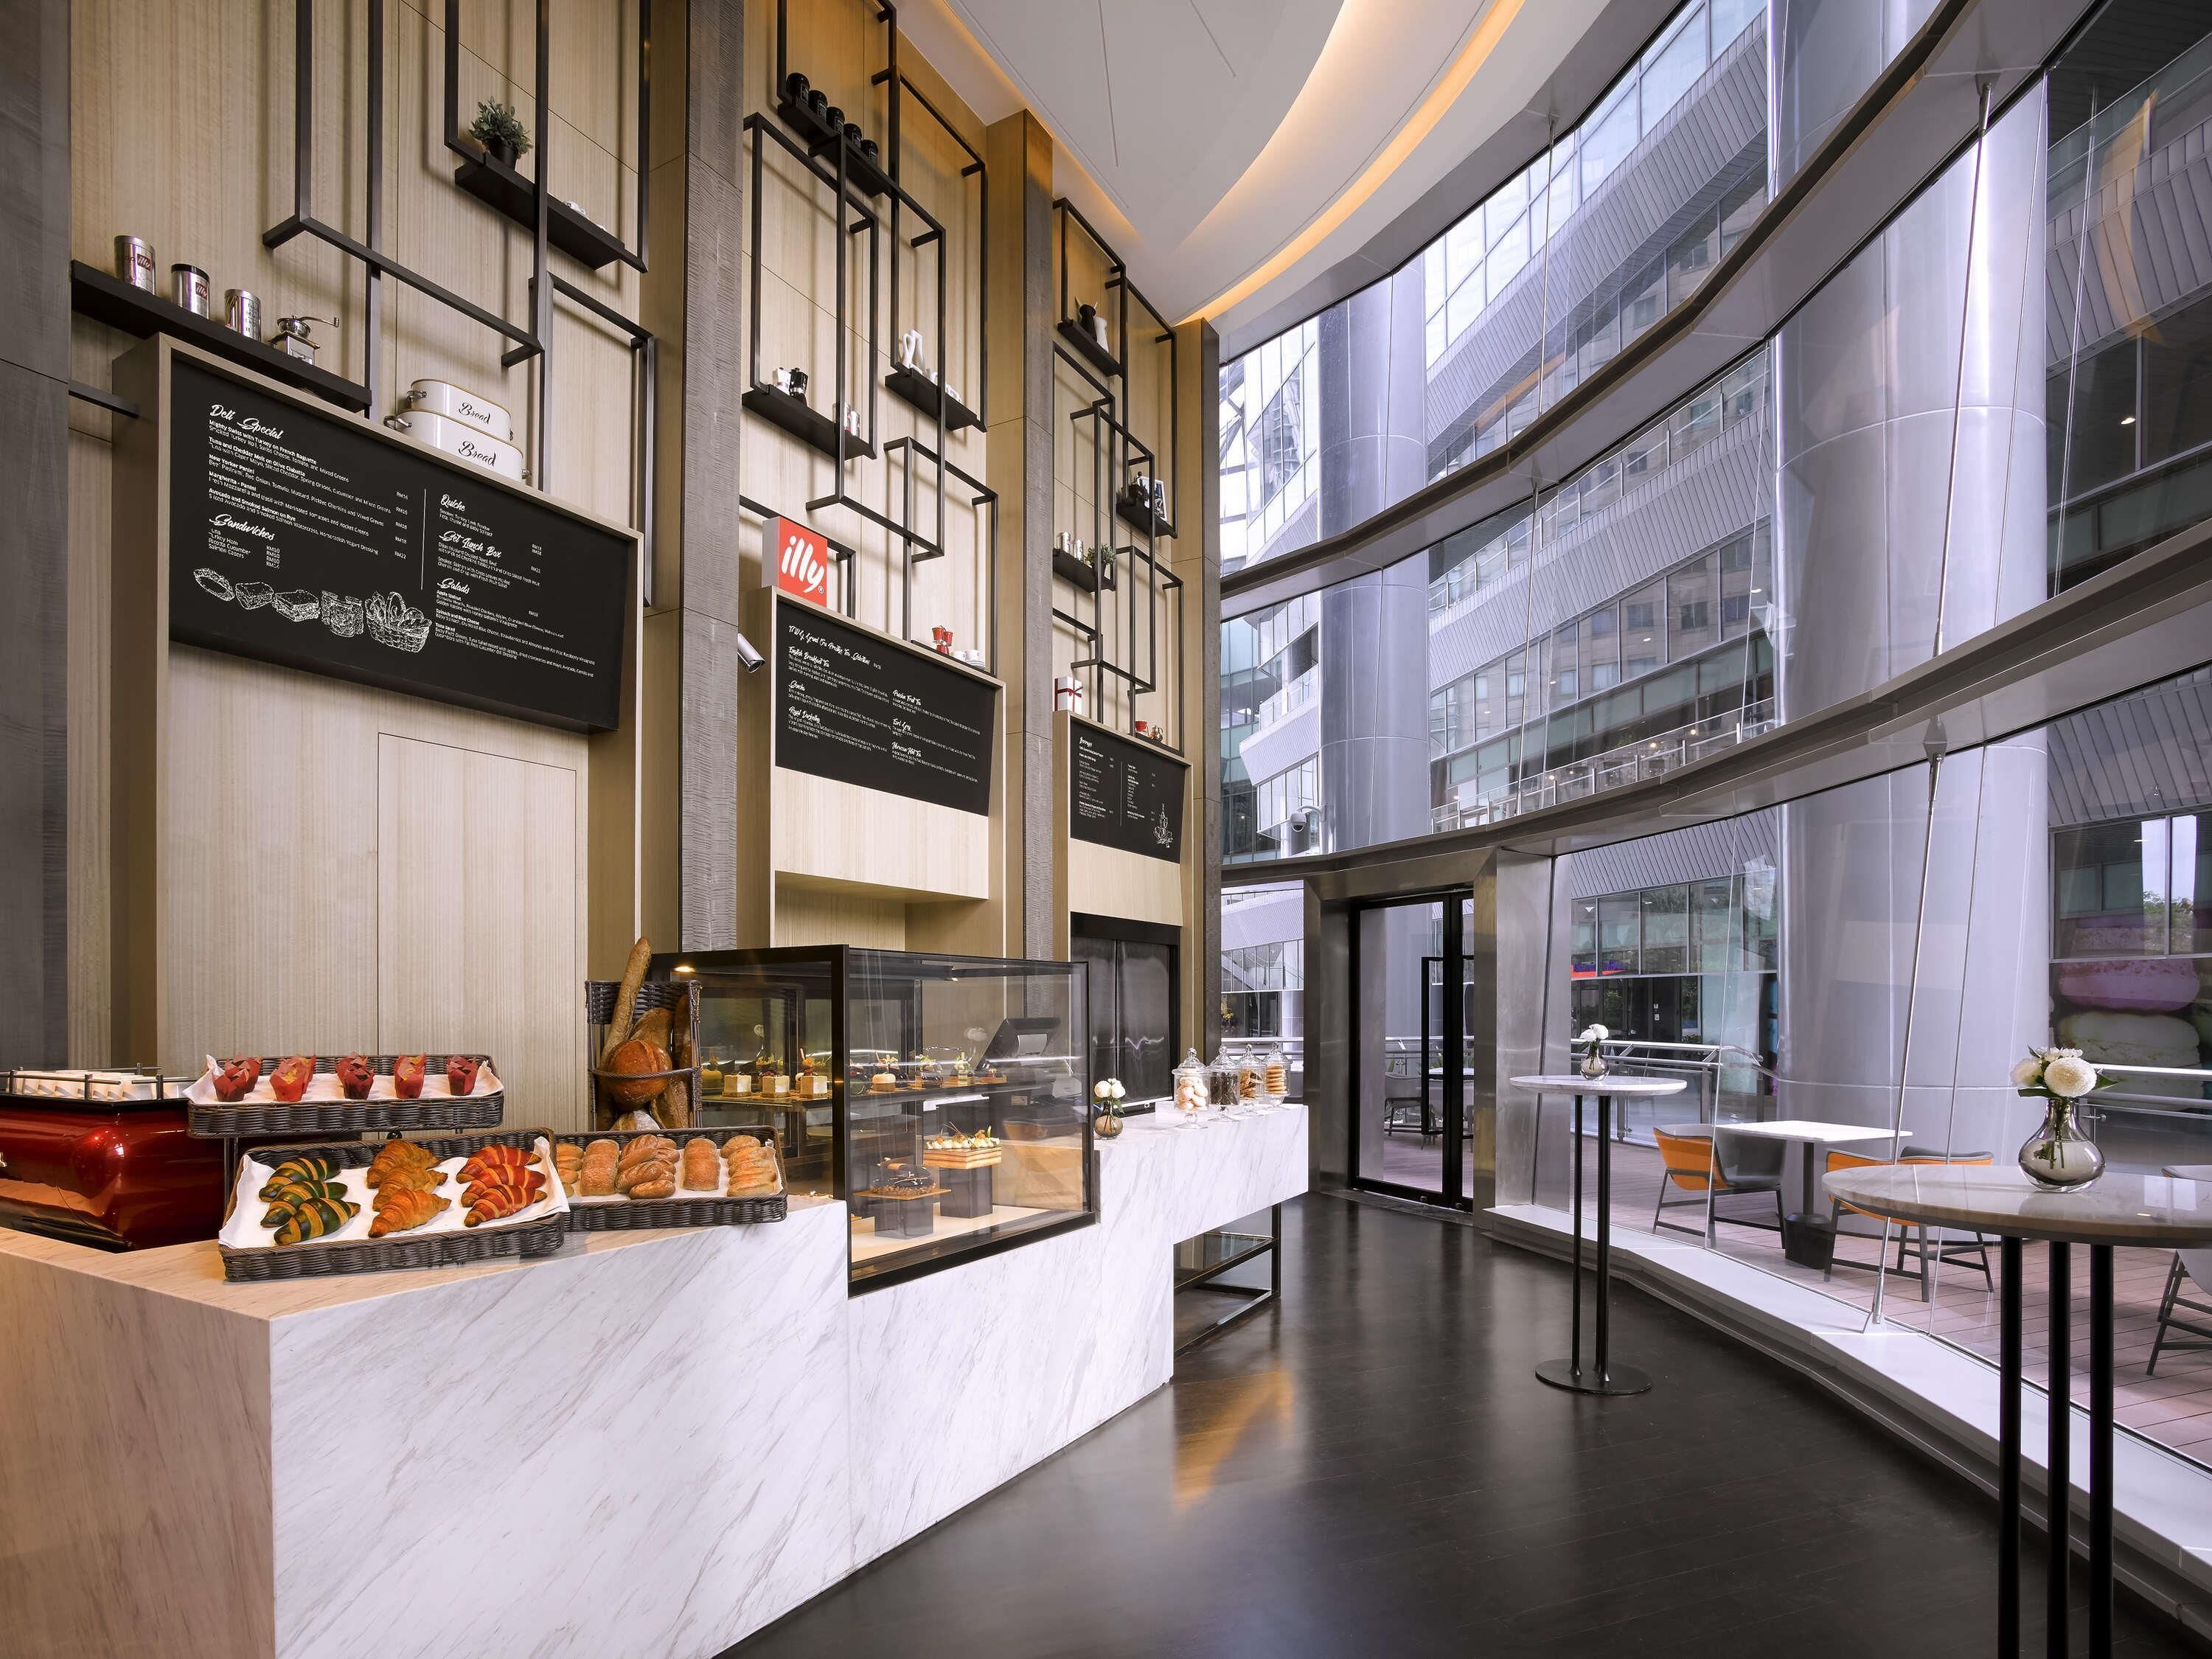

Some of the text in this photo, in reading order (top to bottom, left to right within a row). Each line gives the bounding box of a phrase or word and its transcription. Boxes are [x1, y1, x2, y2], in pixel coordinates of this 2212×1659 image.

[209, 404, 284, 439] Deli Special
[458, 402, 491, 424] Bread
[209, 420, 226, 431] Mighty
[228, 427, 242, 436] Swiss
[243, 433, 254, 441] with
[254, 437, 271, 448] Turkey
[279, 446, 295, 456] French
[296, 453, 316, 465] Baguette
[458, 441, 496, 467] Bread
[209, 437, 222, 445] Tuna
[233, 445, 253, 457] Cheddar
[254, 453, 265, 462] Melt
[273, 461, 285, 469] Olive
[286, 465, 305, 476] Ciabatta
[221, 458, 237, 468] Yorker
[239, 465, 254, 474] Panini
[209, 470, 256, 491] Margherita Panini
[209, 488, 230, 499] Avocado
[241, 498, 260, 509] Smoked
[261, 506, 279, 515] Salmon
[440, 494, 465, 512] Quiche
[209, 514, 275, 540] Sandwiches
[439, 531, 501, 558] Set Lunch Box
[782, 535, 824, 593] illy
[437, 578, 470, 594] Salads
